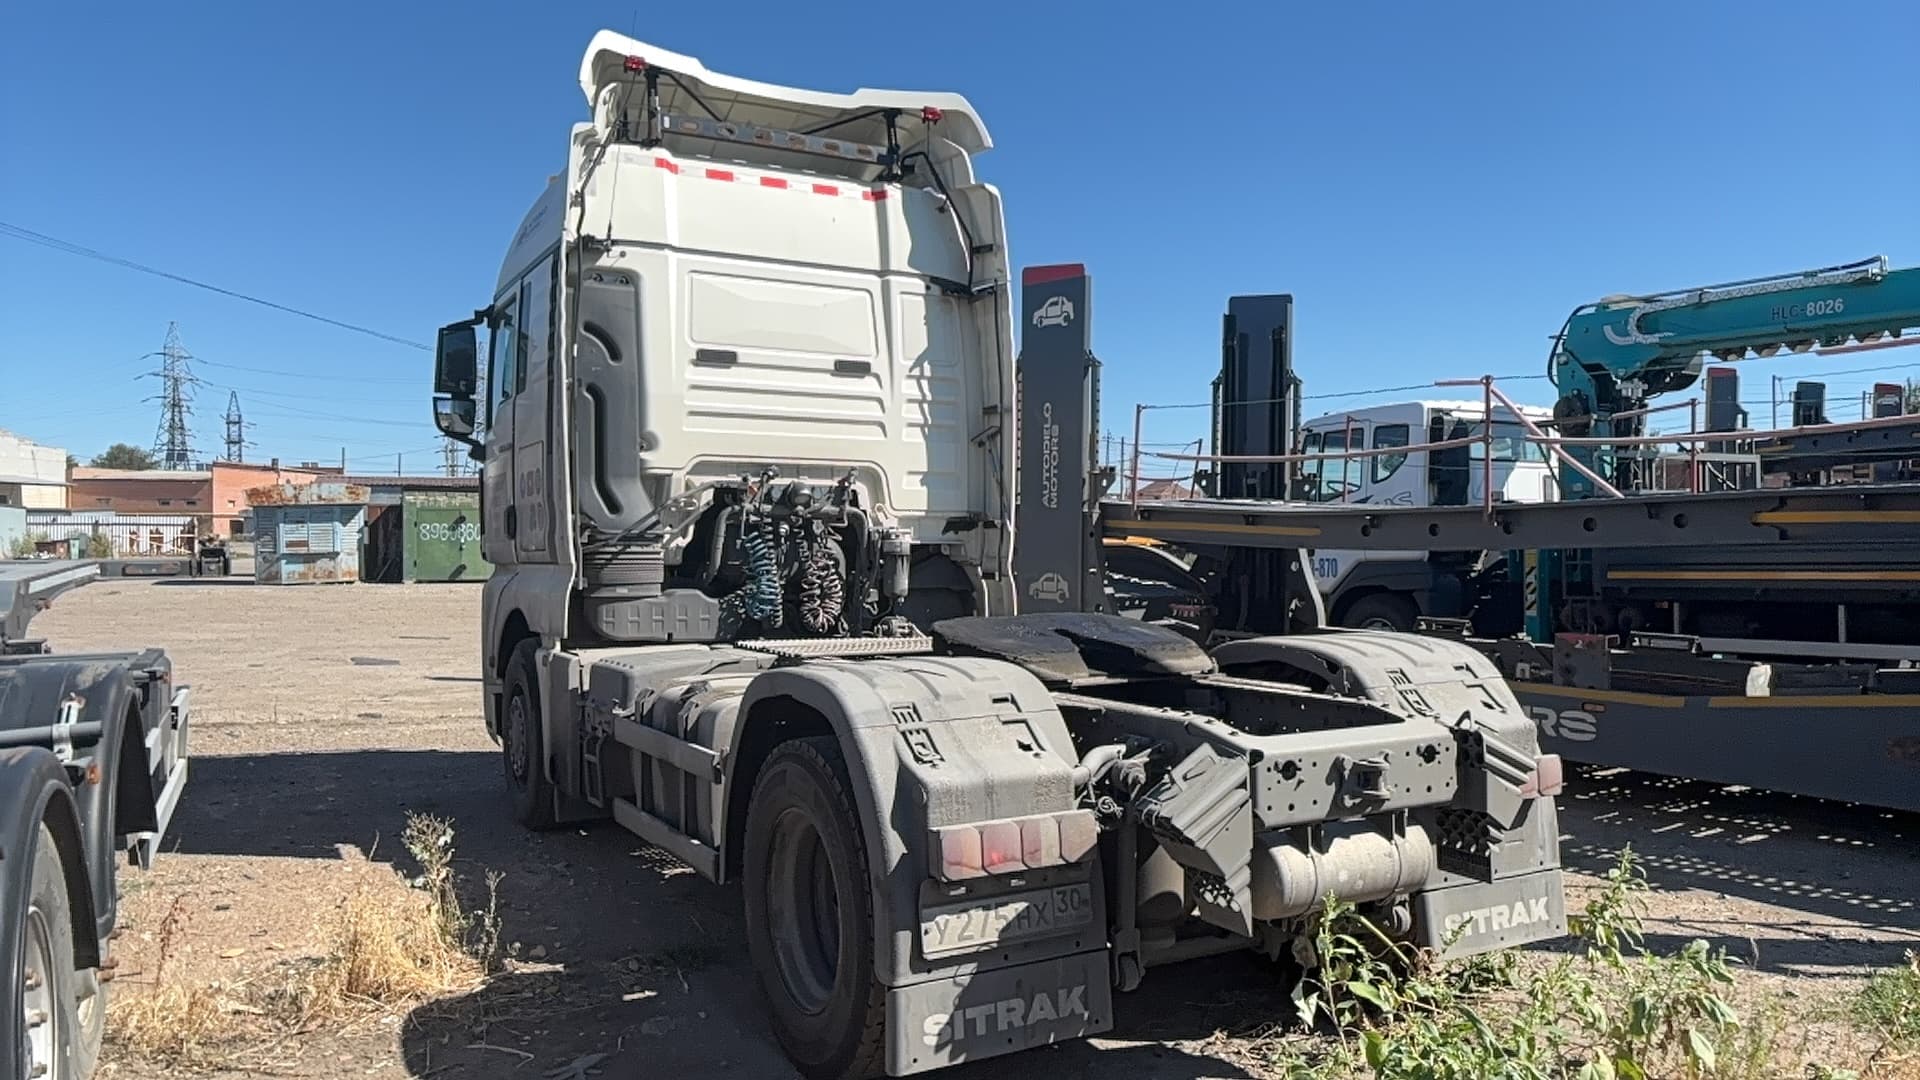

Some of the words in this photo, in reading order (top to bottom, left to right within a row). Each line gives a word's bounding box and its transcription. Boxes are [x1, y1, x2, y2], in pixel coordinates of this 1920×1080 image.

[1042, 402, 1052, 508] AUTODELO
[1050, 424, 1059, 508] MOTORS
[1056, 888, 1081, 913] 30
[1444, 896, 1549, 940] SITRAK
[922, 985, 1087, 1047] SITRAK
